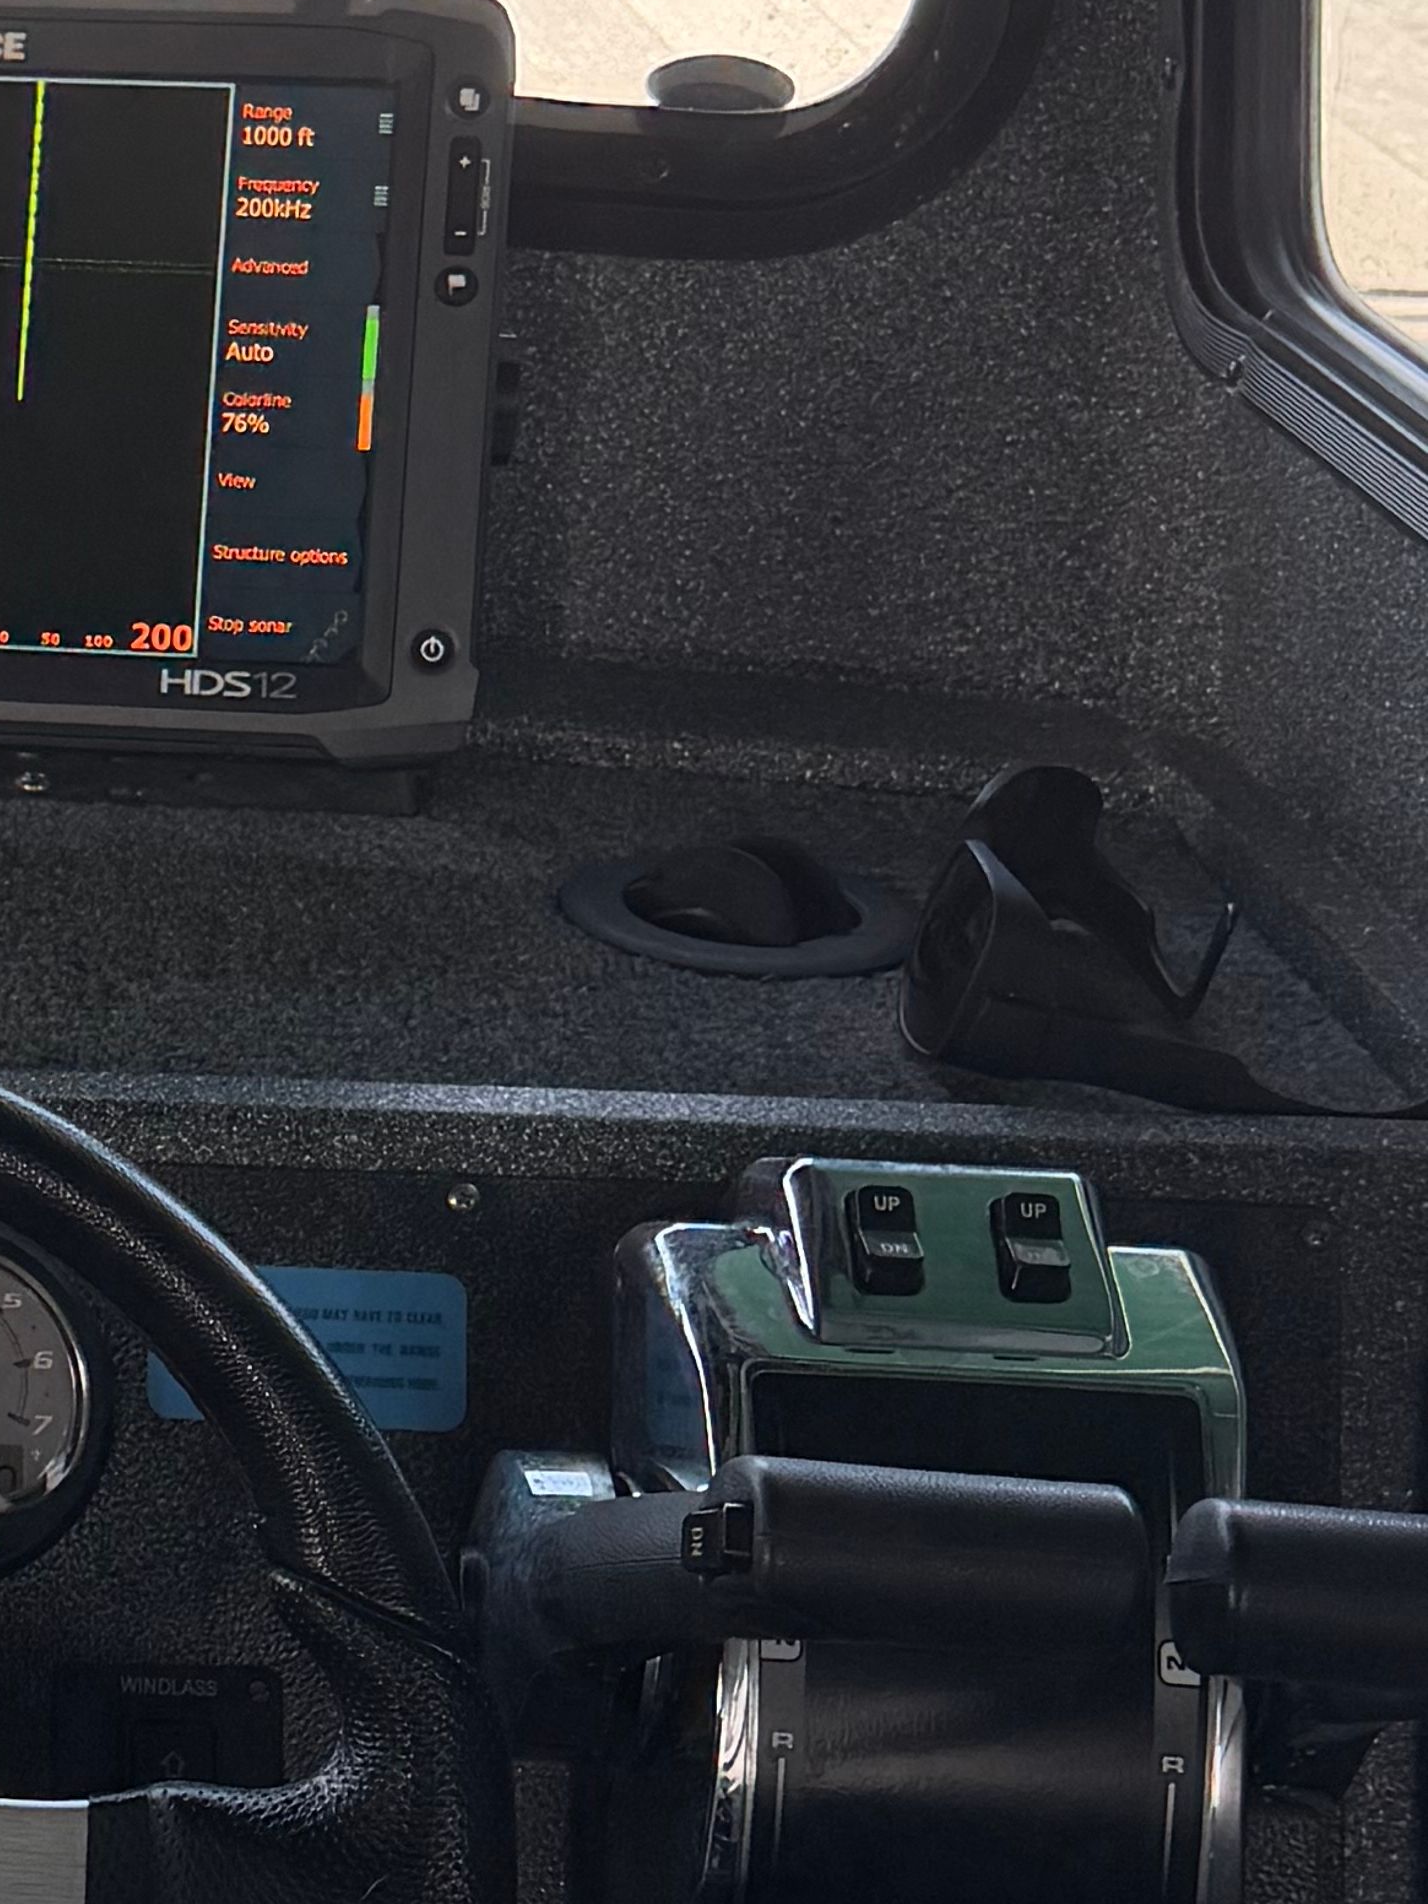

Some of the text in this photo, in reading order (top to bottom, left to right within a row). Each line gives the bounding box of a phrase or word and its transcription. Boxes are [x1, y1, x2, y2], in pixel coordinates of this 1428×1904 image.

[242, 104, 293, 122] Range
[242, 127, 315, 147] 1000 ft
[237, 176, 320, 195] Frequency
[235, 198, 312, 219] 200kHz
[231, 258, 309, 275] Advanced
[228, 319, 309, 339] Sensitivity
[225, 343, 274, 362] Auto
[222, 392, 292, 409] Colorline
[221, 412, 270, 434] 76%
[217, 473, 256, 489] View
[212, 545, 349, 567] Structure options
[208, 616, 292, 635] Stop sonar
[40, 631, 60, 647] 50
[85, 634, 114, 649] 100
[130, 622, 193, 652] 200
[160, 668, 297, 699] HDS12
[874, 1195, 901, 1213] UP
[1020, 1202, 1047, 1219] UP
[2, 1293, 22, 1308] 5
[33, 1351, 53, 1370] 6
[33, 1415, 53, 1435] 7
[120, 1675, 218, 1697] WINDLASS
[772, 1732, 794, 1749] R
[1161, 1756, 1184, 1773] R
